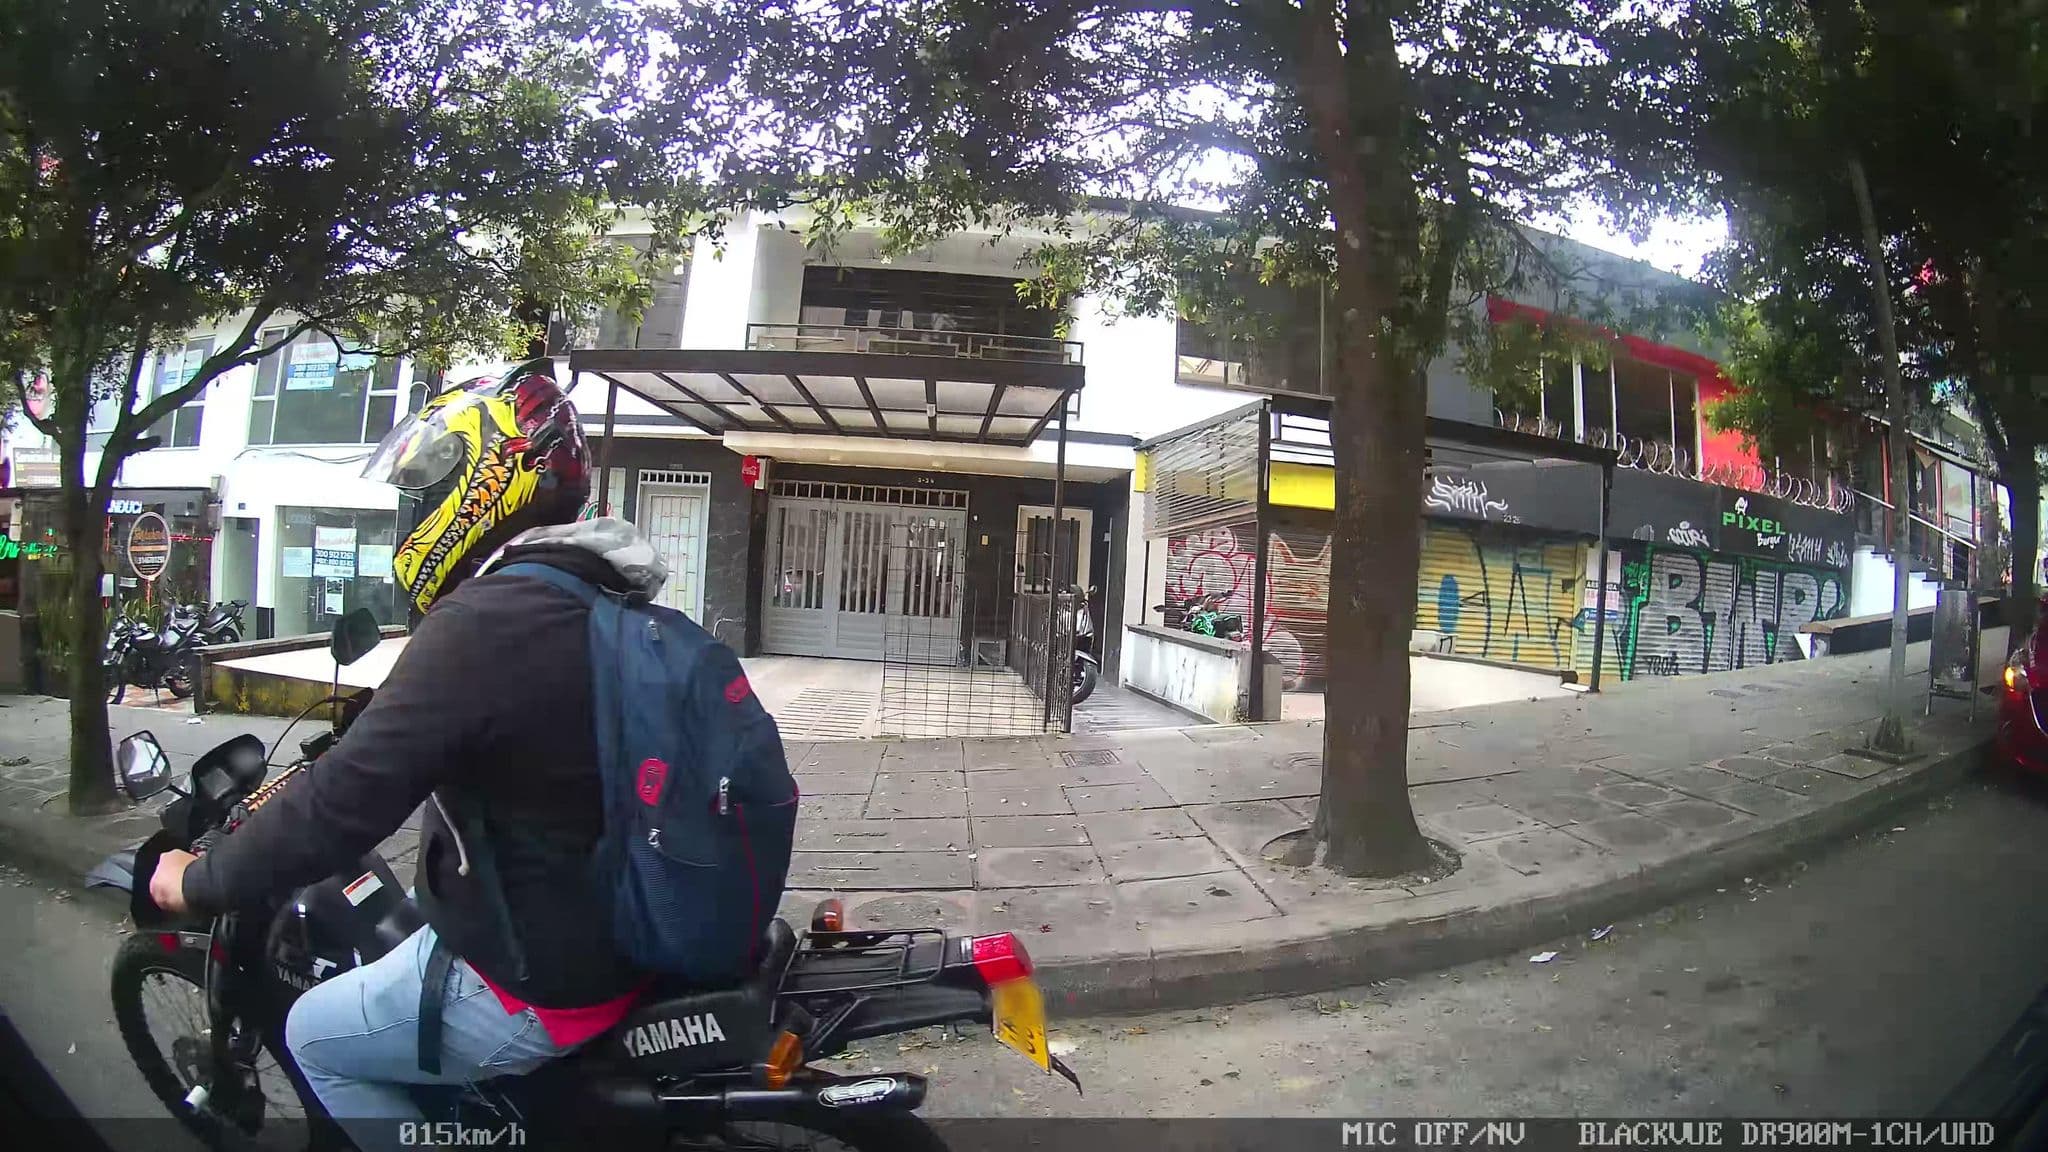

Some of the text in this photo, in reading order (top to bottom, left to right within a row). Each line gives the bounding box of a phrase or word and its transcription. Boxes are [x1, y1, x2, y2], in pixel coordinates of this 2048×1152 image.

[1722, 512, 1785, 535] PIXEL
[1757, 533, 1781, 549] Burger
[622, 1012, 726, 1058] YAMAHA
